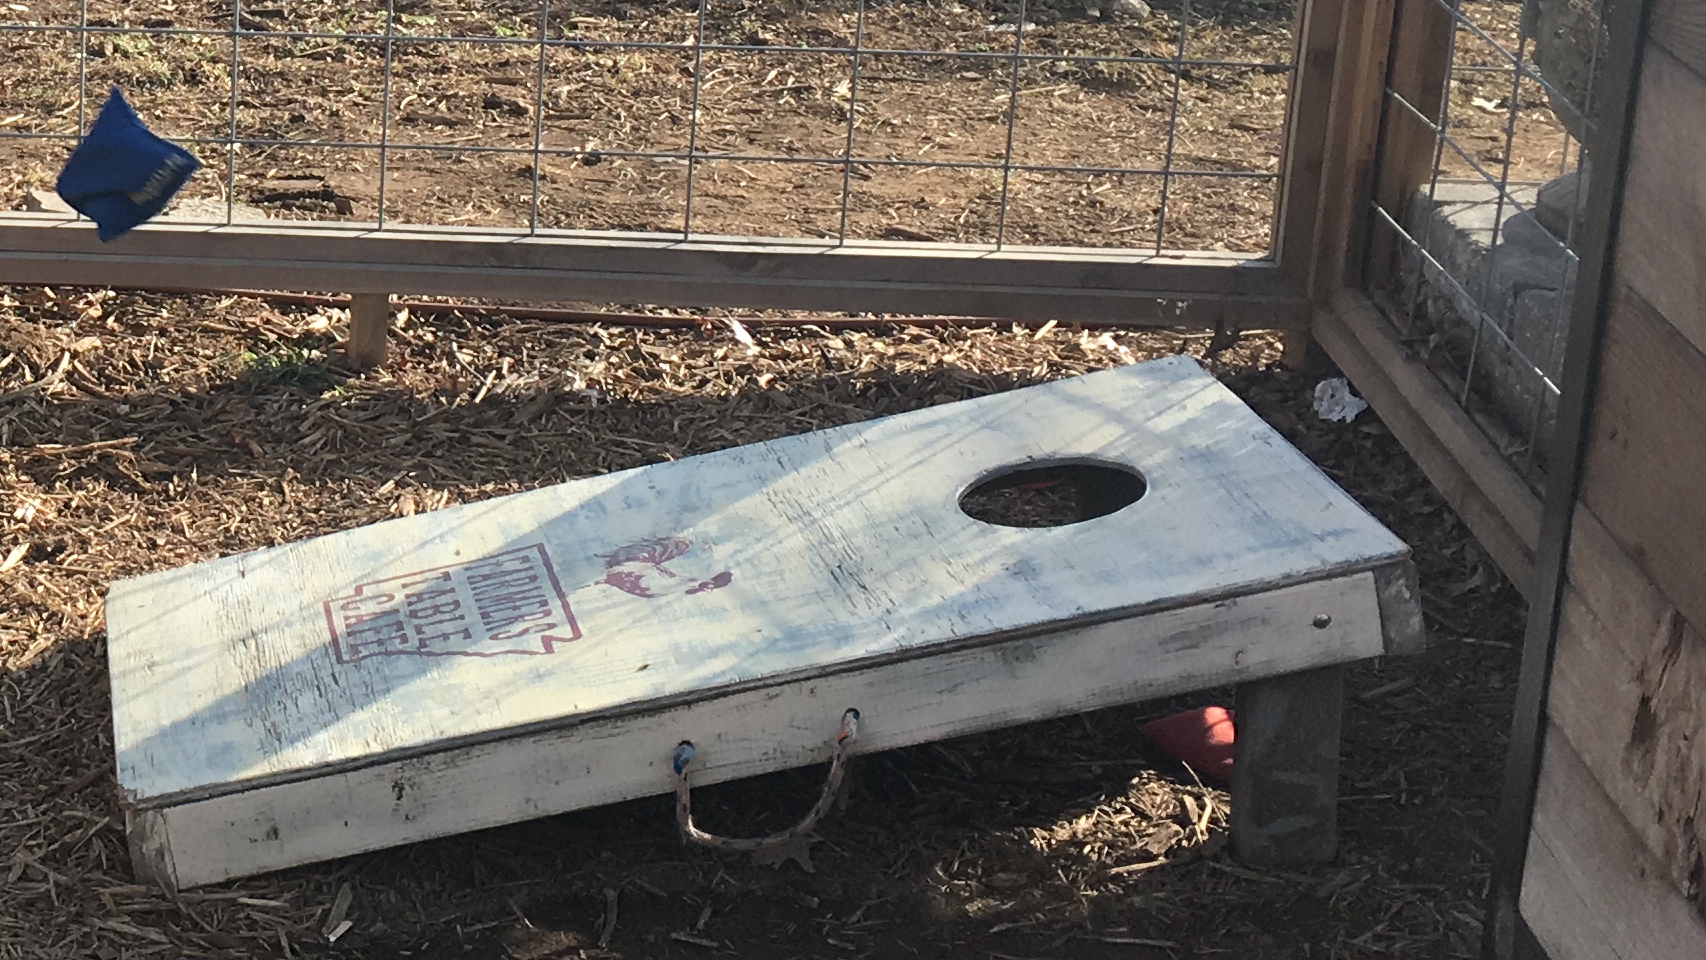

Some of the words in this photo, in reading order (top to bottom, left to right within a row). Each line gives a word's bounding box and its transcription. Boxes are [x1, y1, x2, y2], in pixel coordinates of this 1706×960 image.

[340, 592, 409, 657] CAFE
[401, 570, 472, 650] TABLE
[463, 554, 558, 641] FARMERS
